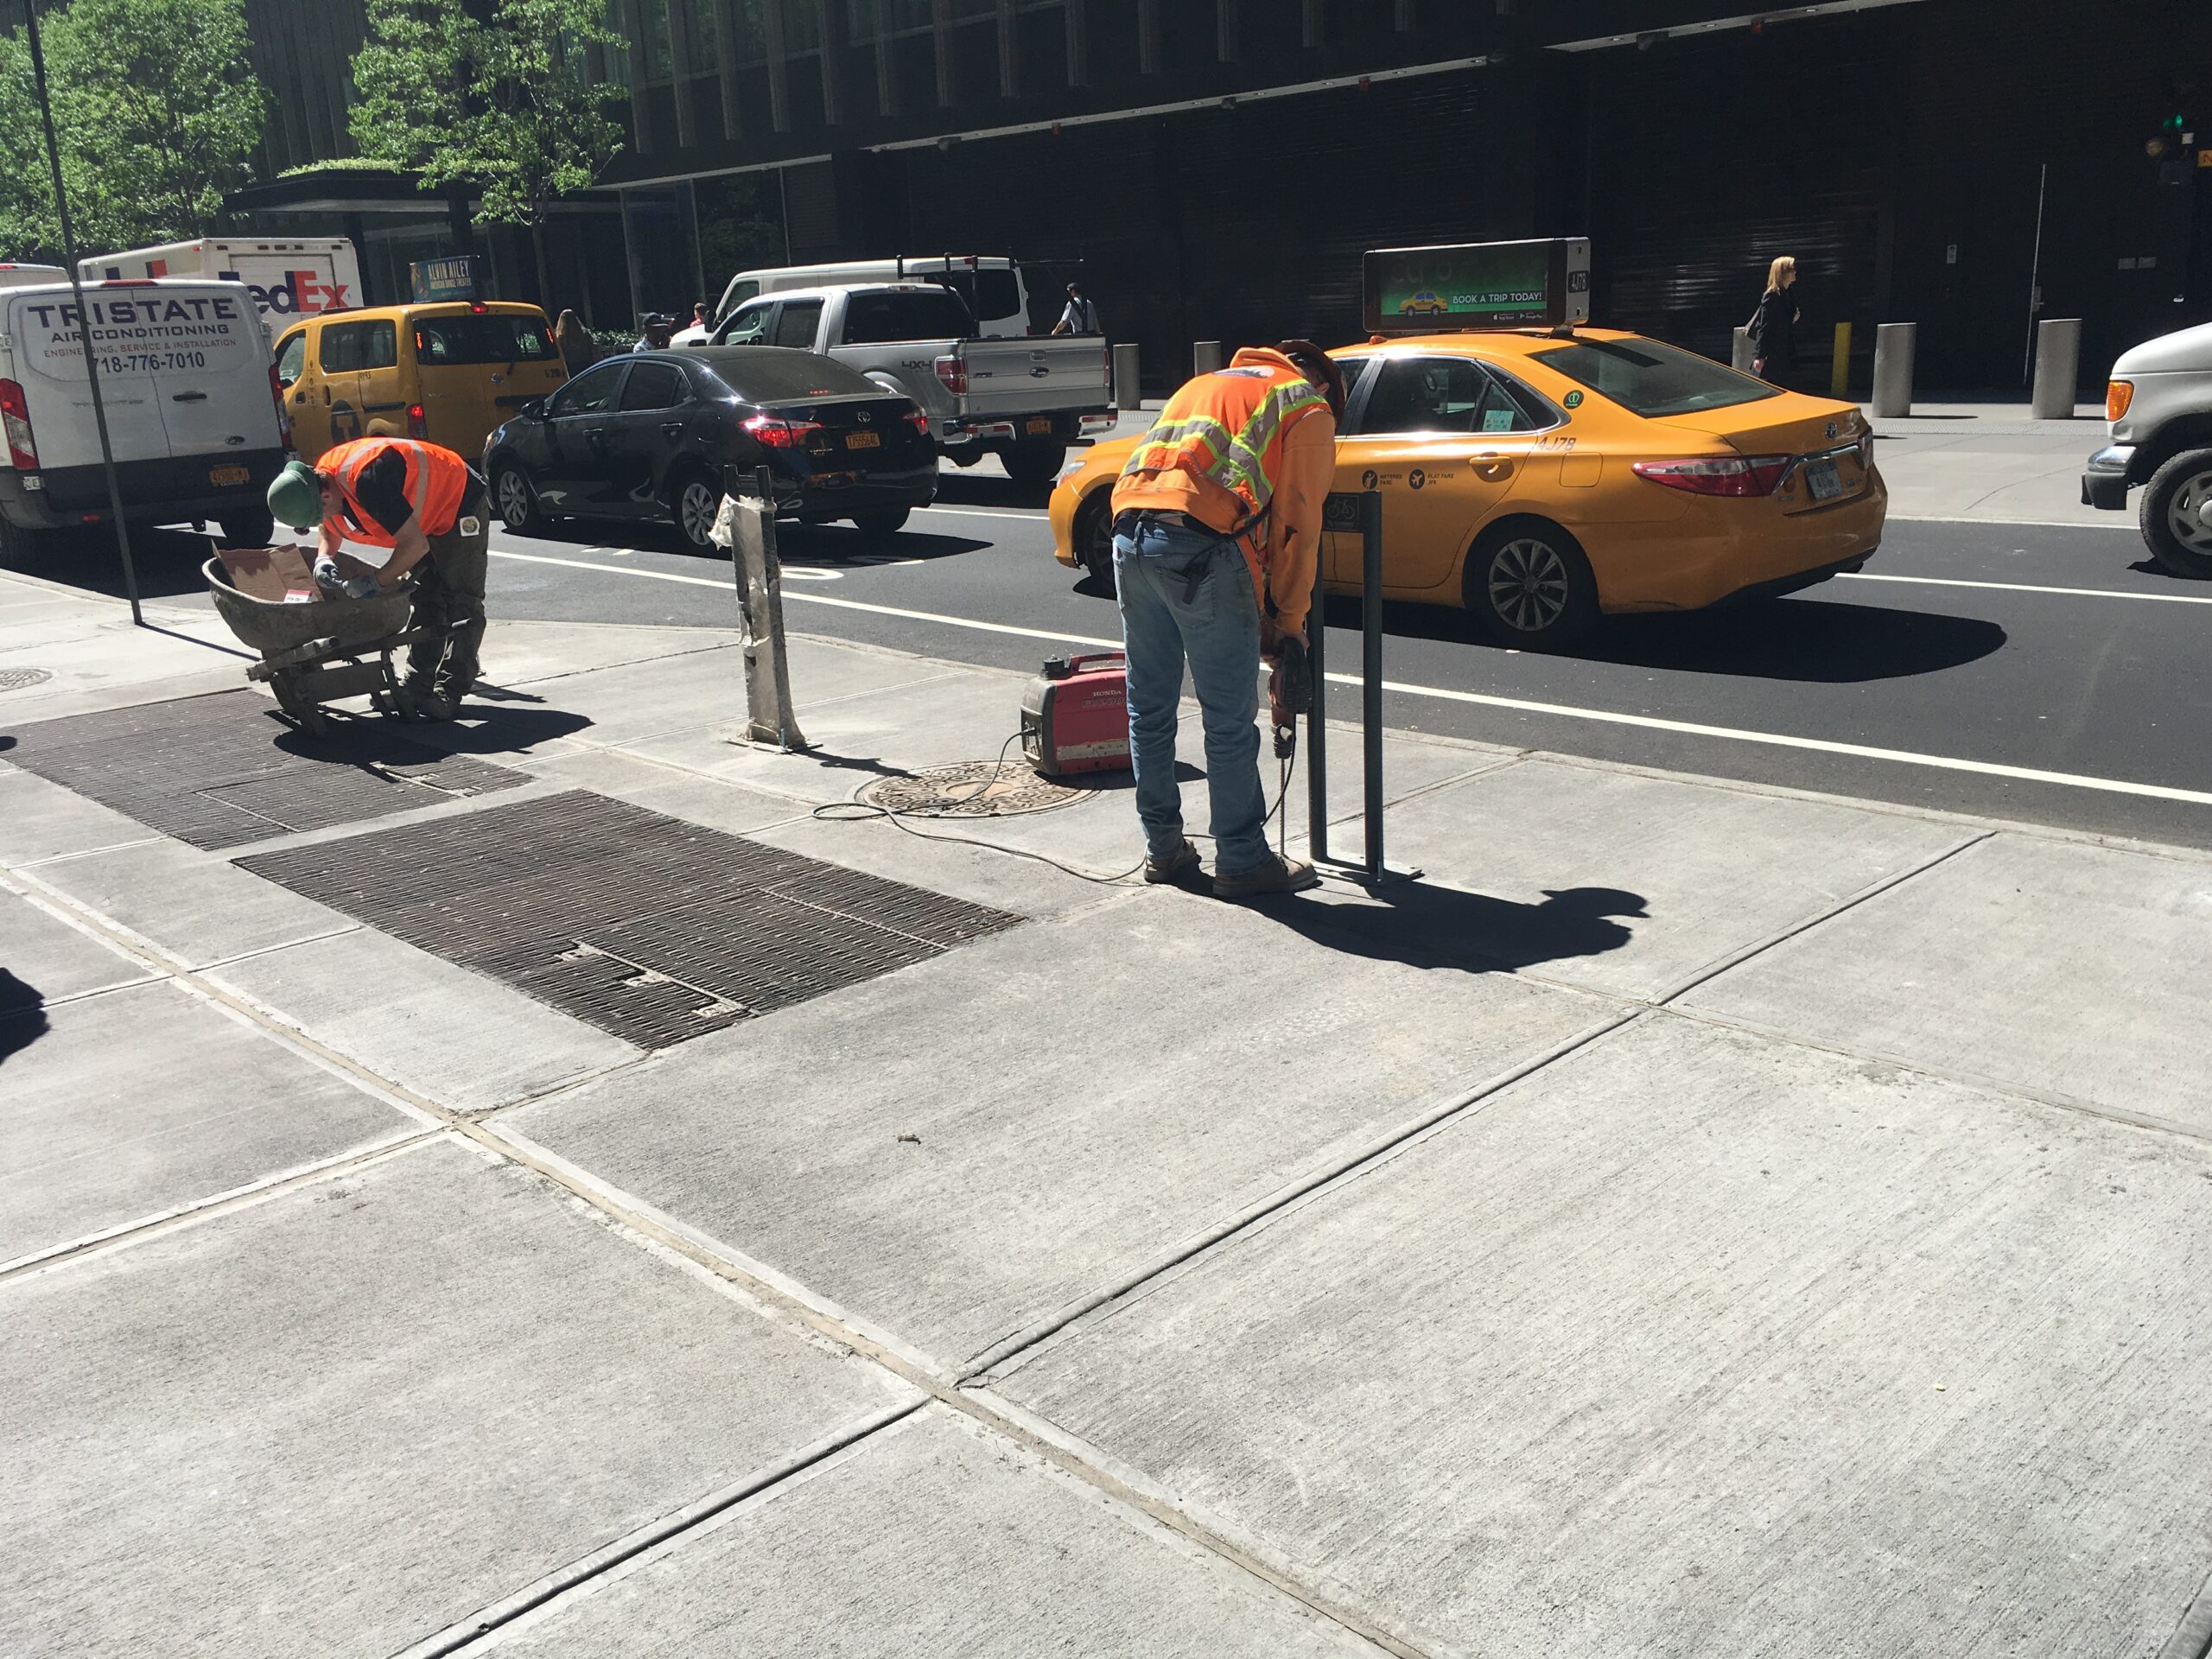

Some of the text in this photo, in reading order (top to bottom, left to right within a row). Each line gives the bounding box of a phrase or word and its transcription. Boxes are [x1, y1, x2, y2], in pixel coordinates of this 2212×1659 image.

[428, 260, 469, 281] ALVIN AILEY
[1571, 273, 1586, 291] 4J78
[219, 270, 348, 317] edEx
[1452, 291, 1542, 304] BOOK A TRIP TODAY!
[28, 298, 238, 328] TRISTATE
[52, 324, 229, 343] AIR CONDITIONING
[44, 345, 118, 358] ENGINERING,
[122, 343, 161, 353] SERVICE
[174, 339, 237, 349] INSTALLATION
[1536, 435, 1577, 451] 4J78
